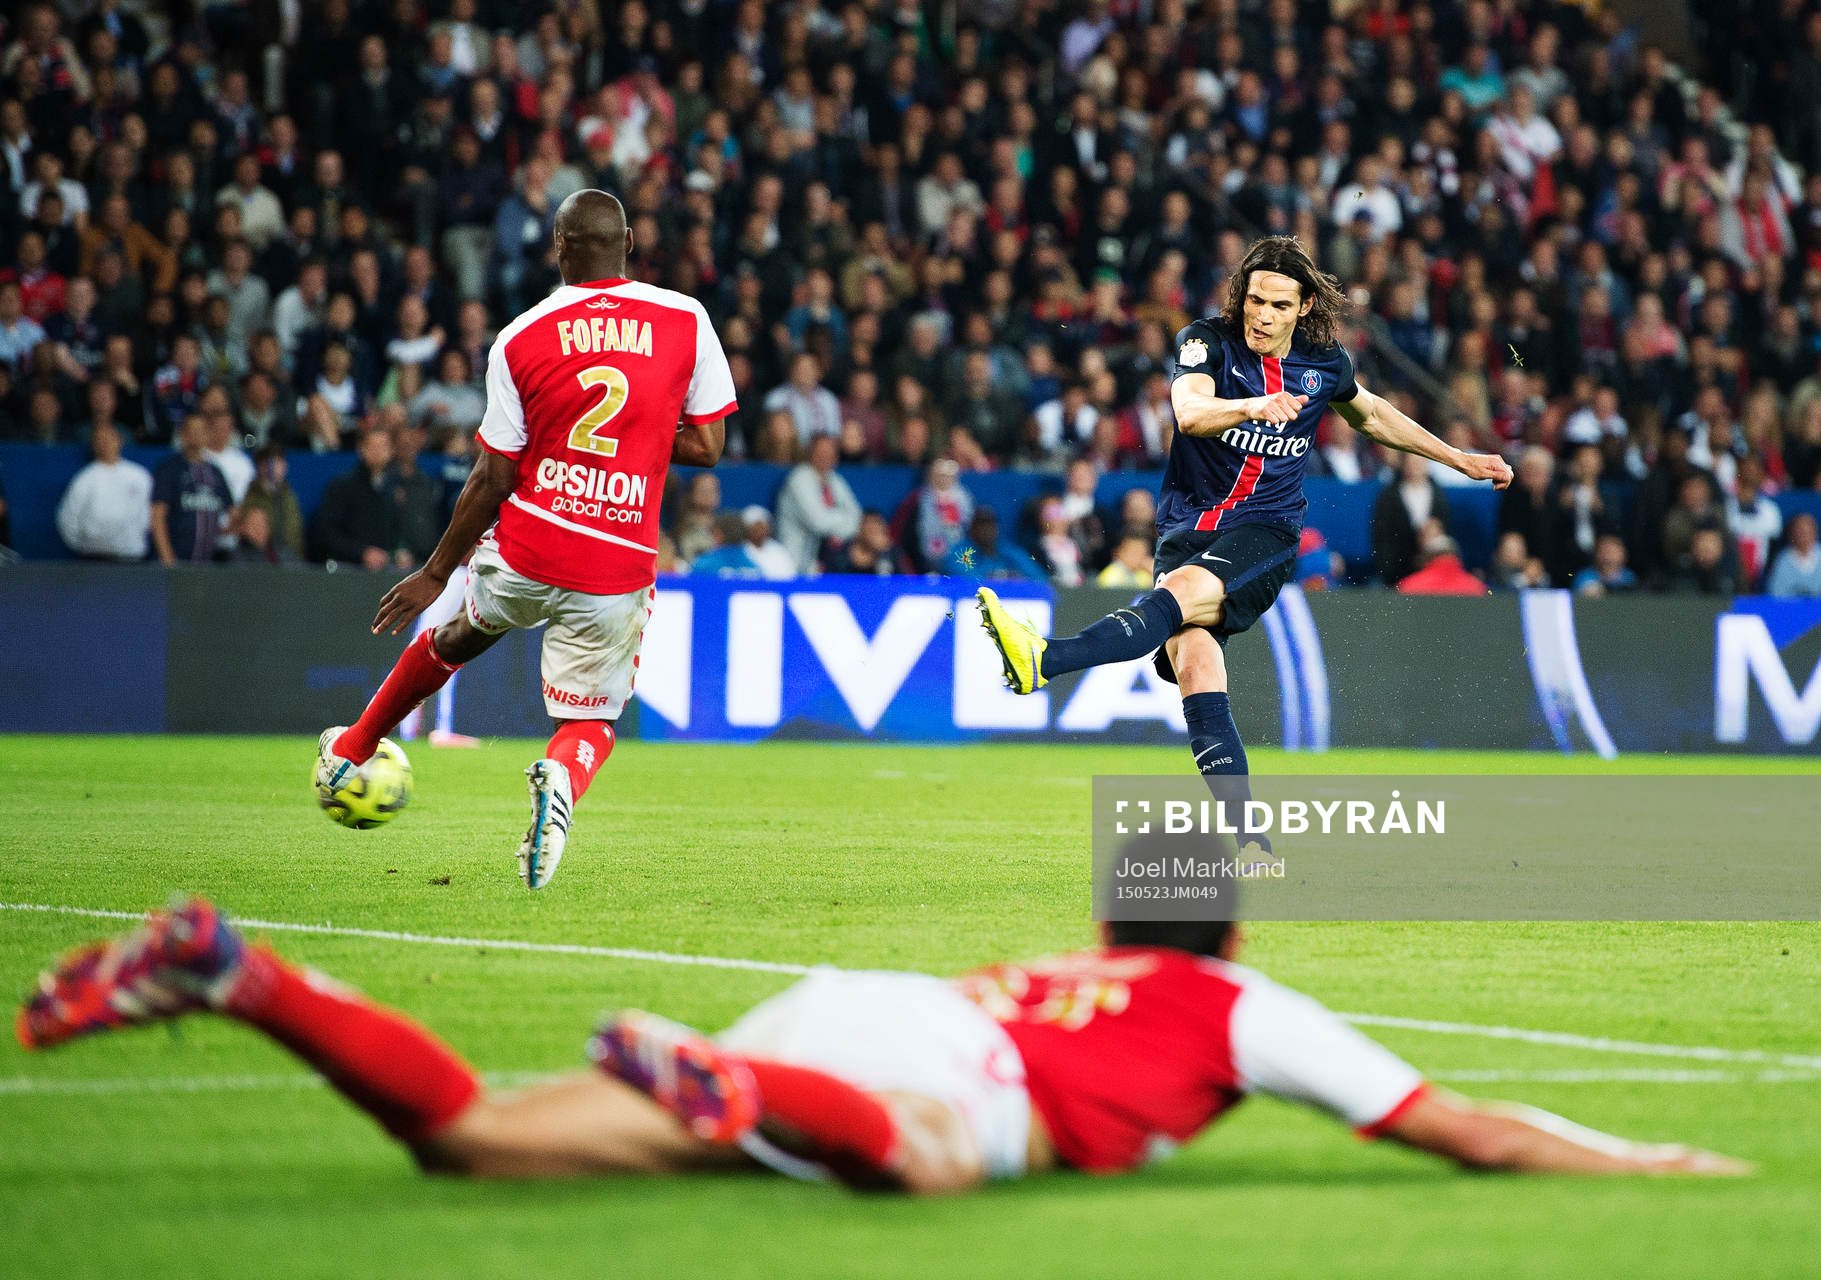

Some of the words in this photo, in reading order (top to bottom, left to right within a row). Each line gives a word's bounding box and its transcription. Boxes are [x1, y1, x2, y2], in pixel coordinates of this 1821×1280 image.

[557, 318, 653, 357] FOFANA
[566, 365, 630, 458] 2
[1216, 426, 1312, 457] mirates
